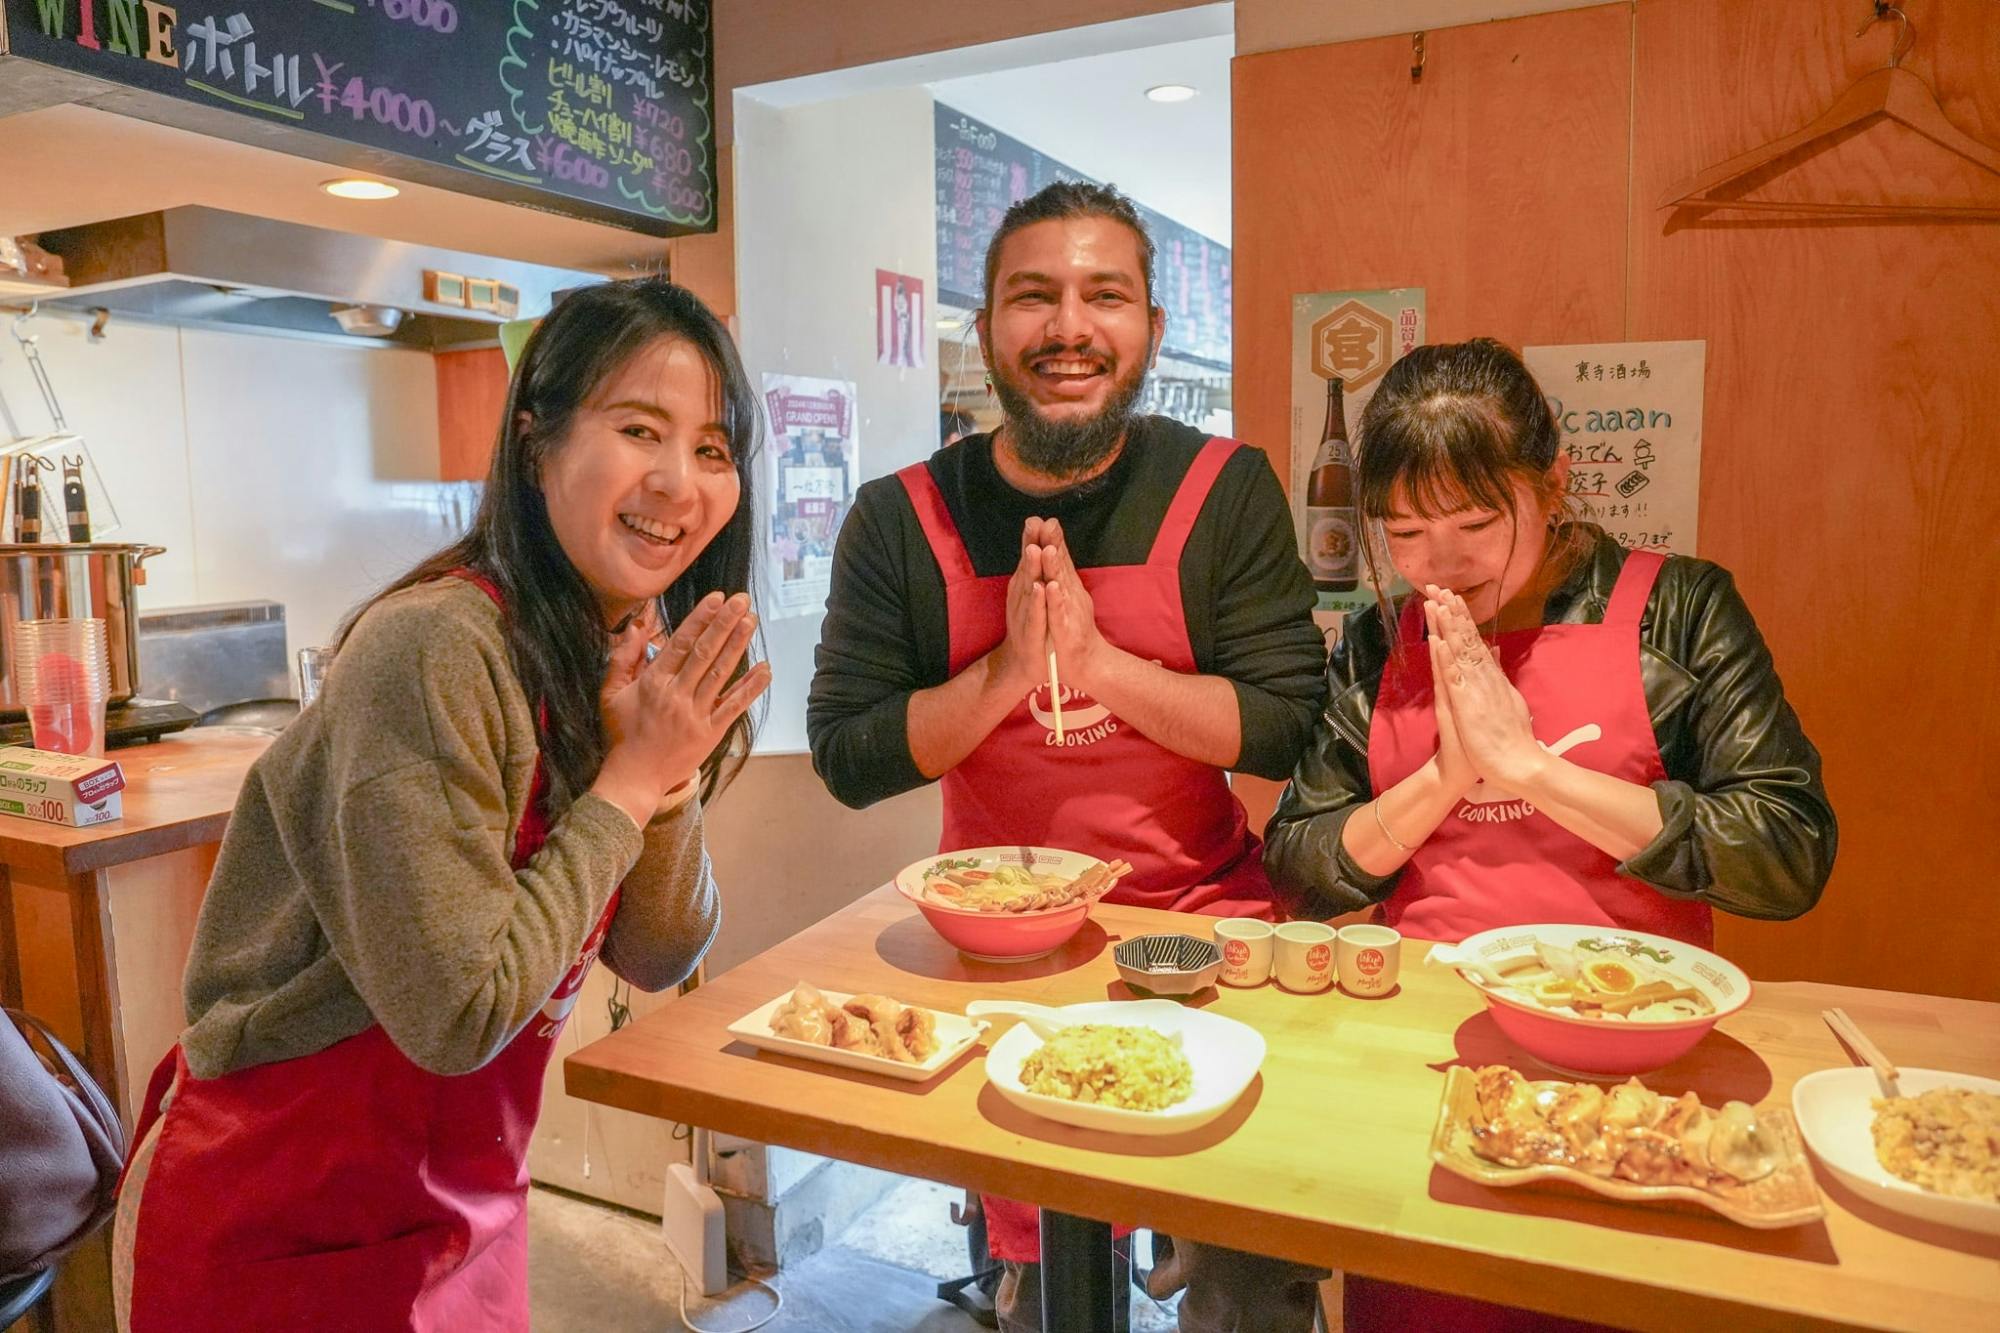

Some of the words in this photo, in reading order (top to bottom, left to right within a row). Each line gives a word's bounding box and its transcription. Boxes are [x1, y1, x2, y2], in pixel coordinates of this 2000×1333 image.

[36, 0, 179, 69] WINE
[564, 0, 663, 42] レープフルーツ
[185, 12, 314, 108] ボトル
[464, 110, 536, 170] グラス
[535, 135, 609, 188] ¥600
[634, 125, 692, 176] ¥680
[652, 166, 705, 212] ¥600
[1576, 360, 1651, 383] 裏寺酒場
[1328, 445, 1341, 457] 25
[1566, 442, 1622, 462] おでん
[1045, 719, 1117, 747] COKING
[1458, 800, 1536, 824] COOKING
